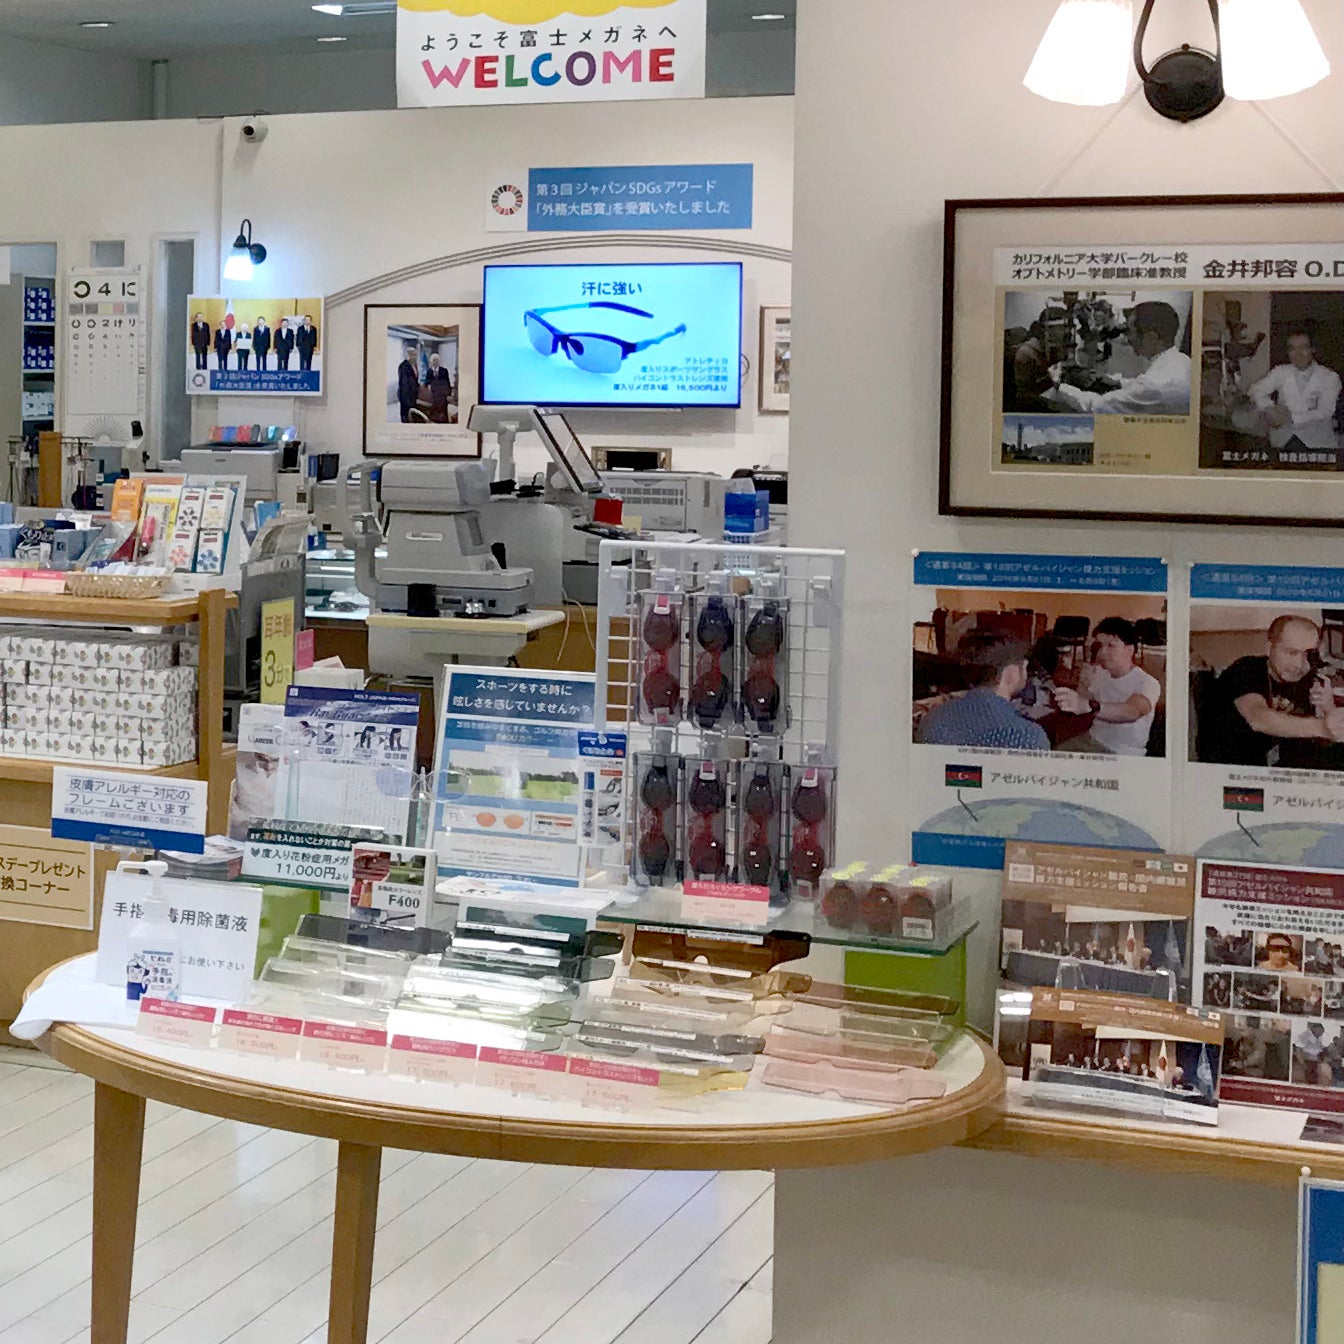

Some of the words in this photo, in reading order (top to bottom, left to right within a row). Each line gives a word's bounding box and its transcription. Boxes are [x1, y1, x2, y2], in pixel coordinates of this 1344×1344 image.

[421, 25, 678, 52] ようこそ富士メガネへ
[421, 48, 676, 89] WELCOME
[581, 280, 643, 297] 汗に強い
[475, 679, 572, 696] スポーツをする時に
[69, 778, 191, 801] 皮膚アレルギー対応の
[388, 894, 420, 909] F400
